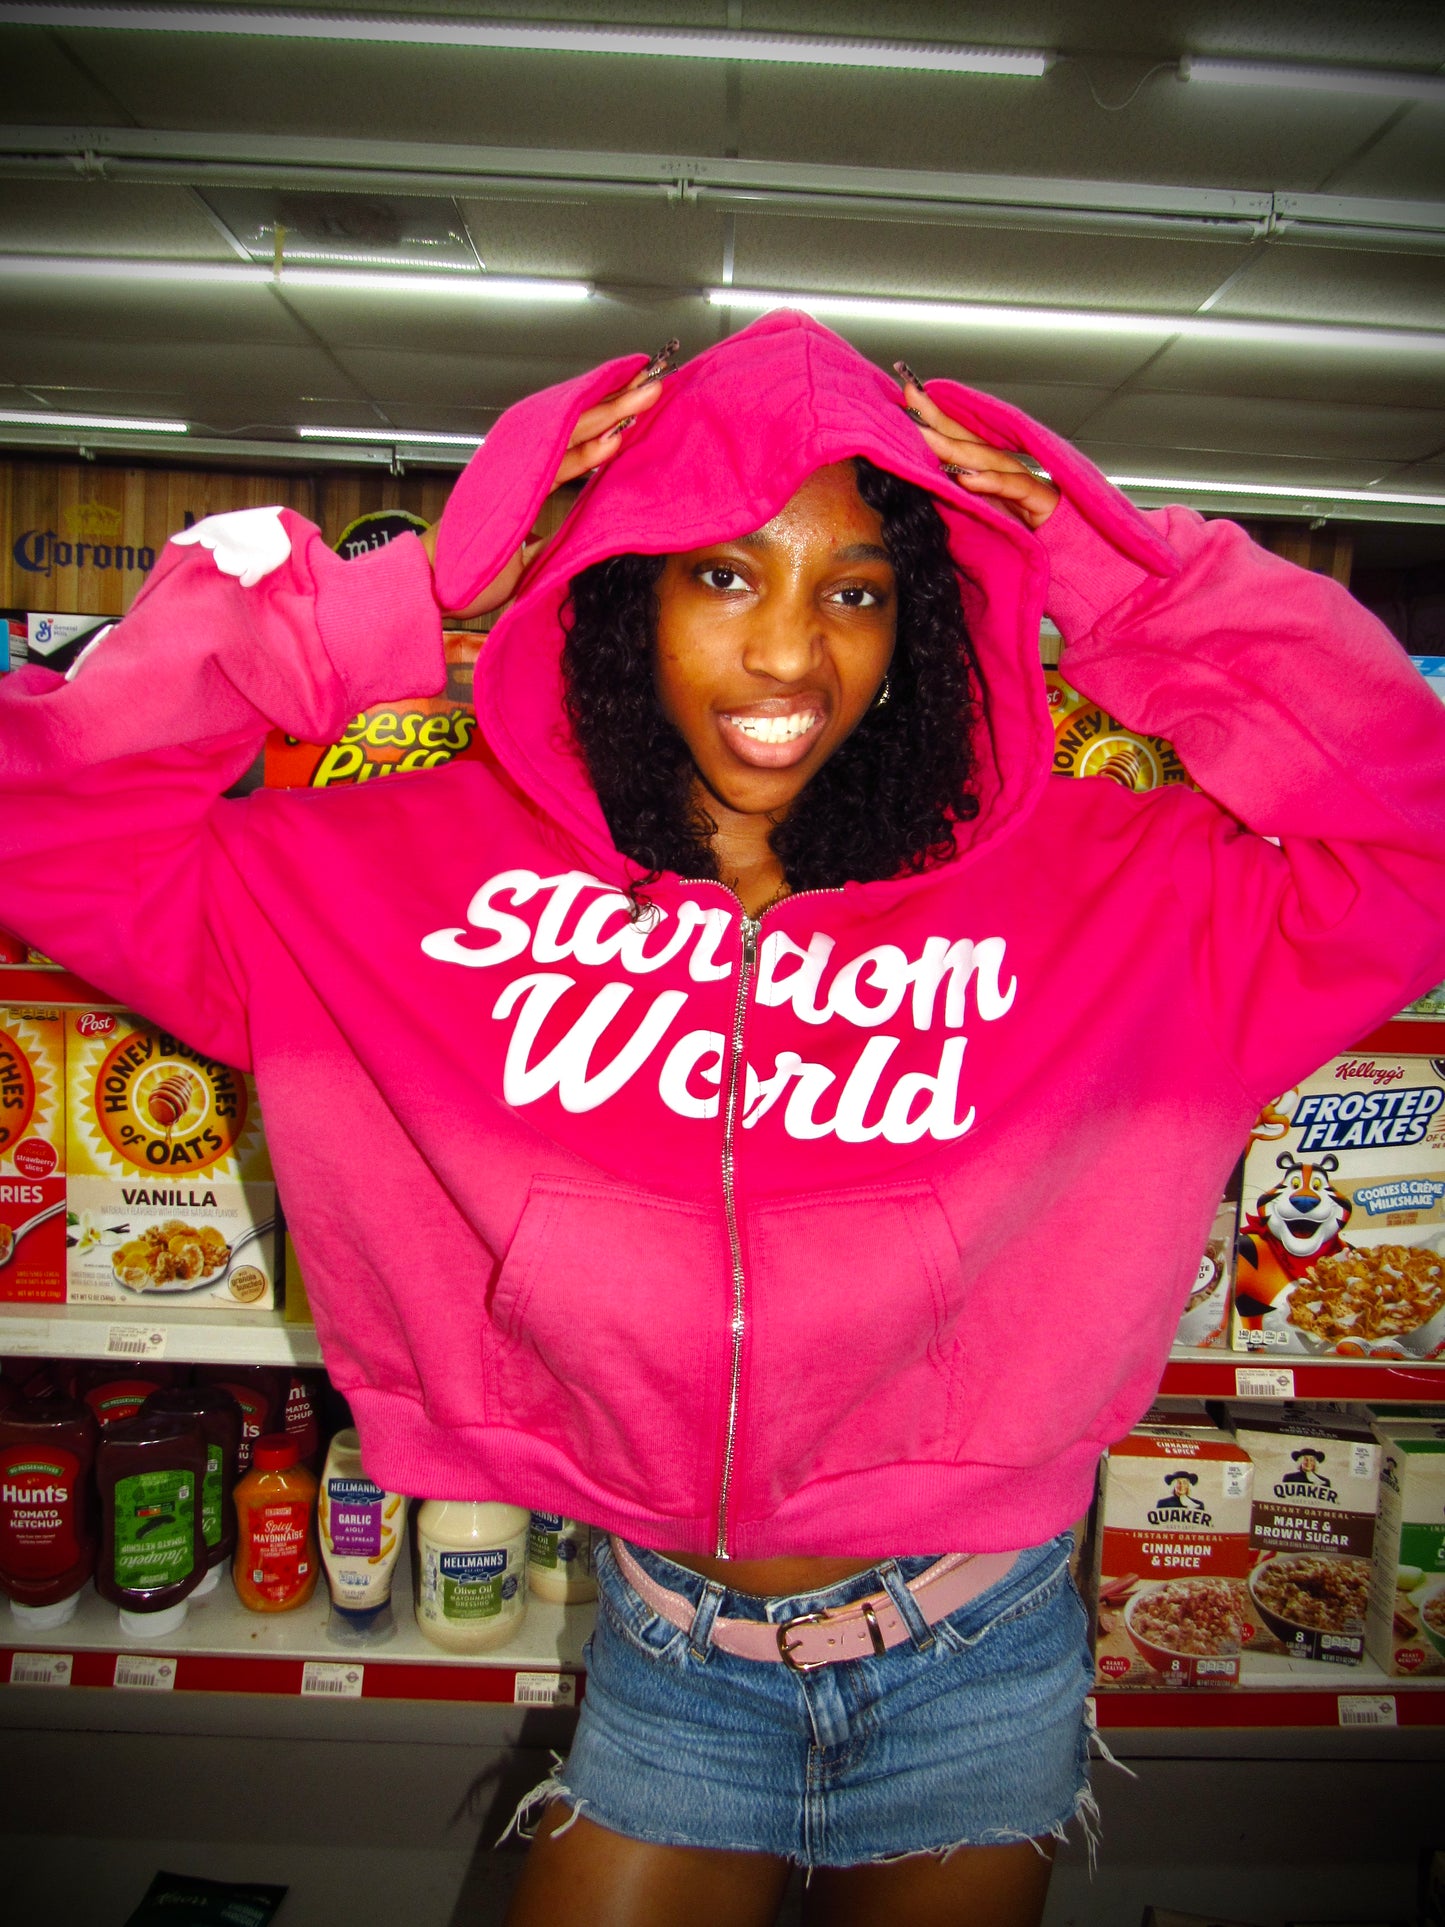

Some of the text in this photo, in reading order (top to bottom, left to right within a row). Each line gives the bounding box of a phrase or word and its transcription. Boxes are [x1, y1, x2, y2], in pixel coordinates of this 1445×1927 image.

[1047, 689, 1060, 704] st
[288, 710, 477, 749] eese's
[80, 1013, 113, 1033] Post
[491, 972, 976, 1145] World
[104, 1036, 154, 1113] HONEY
[1335, 1059, 1405, 1086] Kellogg's
[1296, 1088, 1443, 1126] FROSTED
[1302, 1115, 1428, 1150] FLAKES
[121, 1124, 224, 1165] of OATS
[16, 1154, 55, 1168] strawberry
[24, 1163, 44, 1173] slices
[121, 1188, 218, 1208] VANILLA
[1357, 1183, 1400, 1202] COOKIES
[1400, 1182, 1409, 1194] &
[1369, 1194, 1433, 1212] MILKSHAKE
[285, 1403, 311, 1414] MATO
[287, 1410, 313, 1422] CHUP
[1156, 1441, 1200, 1451] CINNAMON
[1172, 1448, 1196, 1456] SPICE
[2, 1484, 68, 1504] Hunt's
[1273, 1483, 1338, 1504] QUAKER
[13, 1509, 59, 1520] TOMATO
[1147, 1508, 1212, 1528] QUAKER
[1259, 1503, 1349, 1519] INSTANT OATMEAL
[10, 1519, 63, 1529] KETCHUP
[264, 1519, 293, 1533] Spicy
[338, 1513, 372, 1525] GARLIC
[1273, 1516, 1332, 1532] MAPLE &
[253, 1529, 304, 1543] MAYONNAISE
[352, 1535, 374, 1543] SPREAD
[1133, 1532, 1223, 1542] INSTANT OATMEAL
[1254, 1525, 1350, 1546] BROWN SUGAR
[121, 1535, 187, 1554] TOMATO KETCHUP
[1142, 1542, 1212, 1556] CINNAMON
[444, 1552, 504, 1568] HELLMANN'S
[1151, 1555, 1201, 1568] & SPICE
[454, 1585, 493, 1595] Olive Oil
[455, 1599, 490, 1607] DRESSING
[1295, 1631, 1305, 1642] 8
[1171, 1659, 1180, 1671] 8
